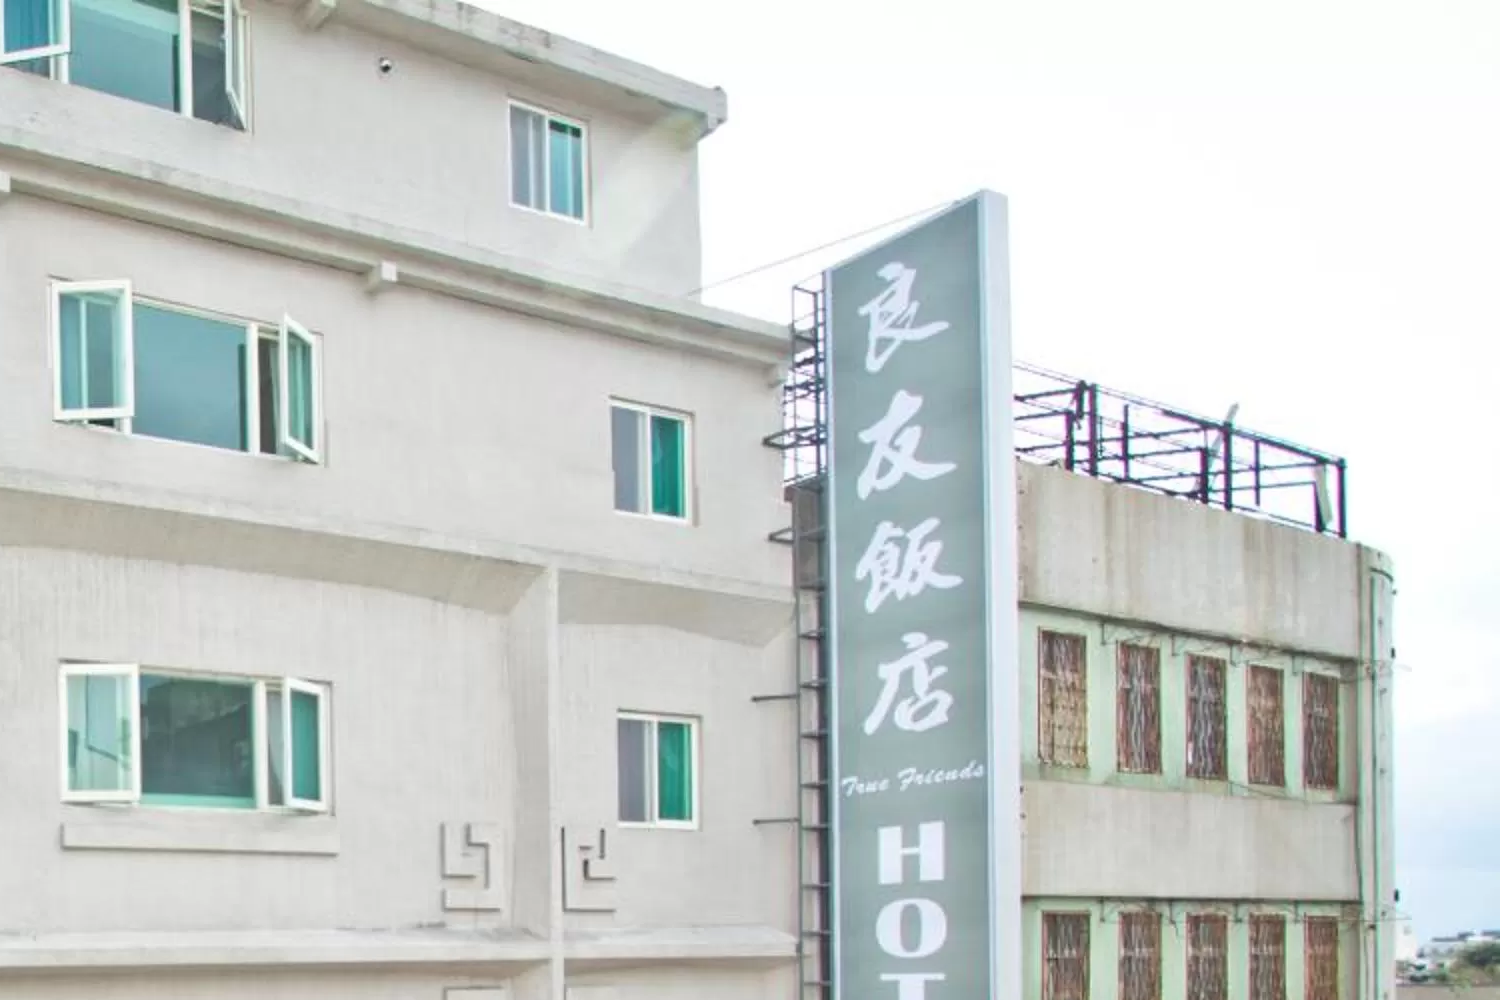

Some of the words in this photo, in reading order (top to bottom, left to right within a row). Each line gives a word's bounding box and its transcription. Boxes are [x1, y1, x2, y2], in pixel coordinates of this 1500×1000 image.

[852, 261, 963, 736] 良友飯店
[842, 775, 889, 797] True
[898, 760, 984, 791] Friends
